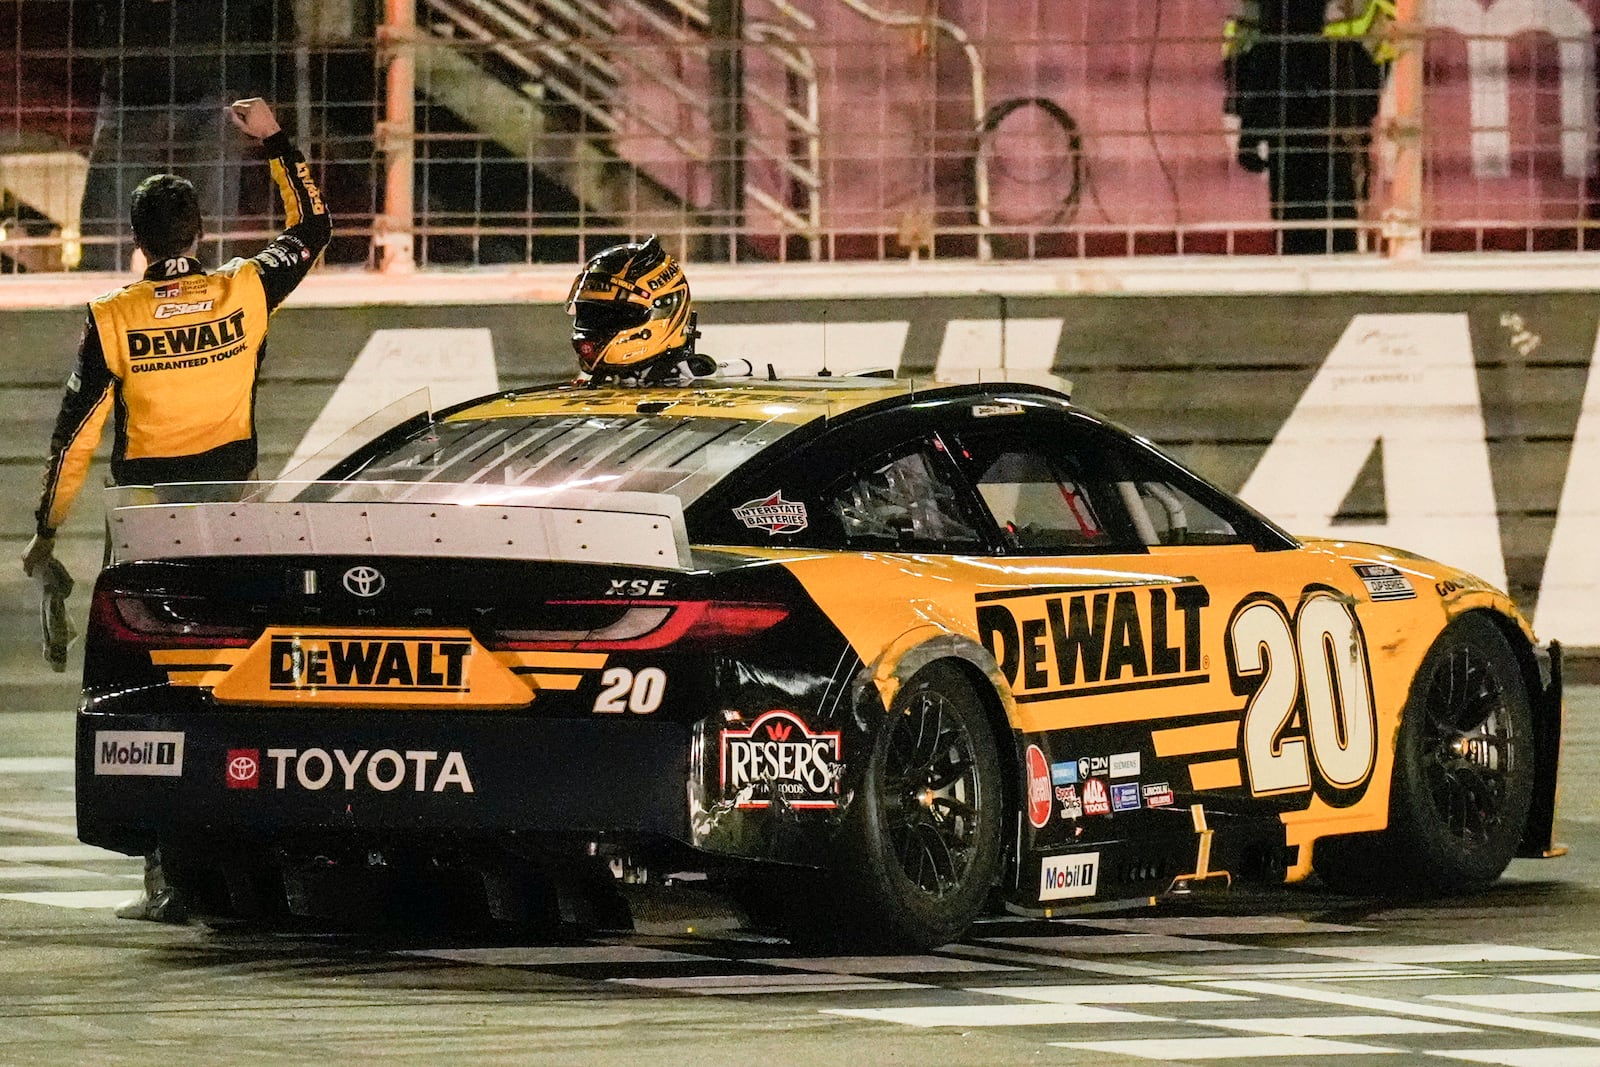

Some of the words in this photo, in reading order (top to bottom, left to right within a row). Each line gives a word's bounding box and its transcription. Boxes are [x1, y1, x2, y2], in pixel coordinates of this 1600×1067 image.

[165, 257, 190, 277] 20
[127, 310, 245, 357] DEWALT
[131, 356, 209, 374] GUARANTEED
[737, 504, 804, 518] INTERSTATE
[747, 514, 805, 526] BATTERIES
[605, 580, 669, 596] XSE
[270, 641, 472, 686] DEWALT
[592, 667, 668, 714] 20
[1229, 590, 1376, 798] 20
[101, 741, 153, 765] Mobil
[267, 748, 474, 793] TOYOTA
[730, 739, 831, 793] RESER'S
[1084, 803, 1109, 814] TOOLS
[1045, 864, 1080, 890] Mobil
